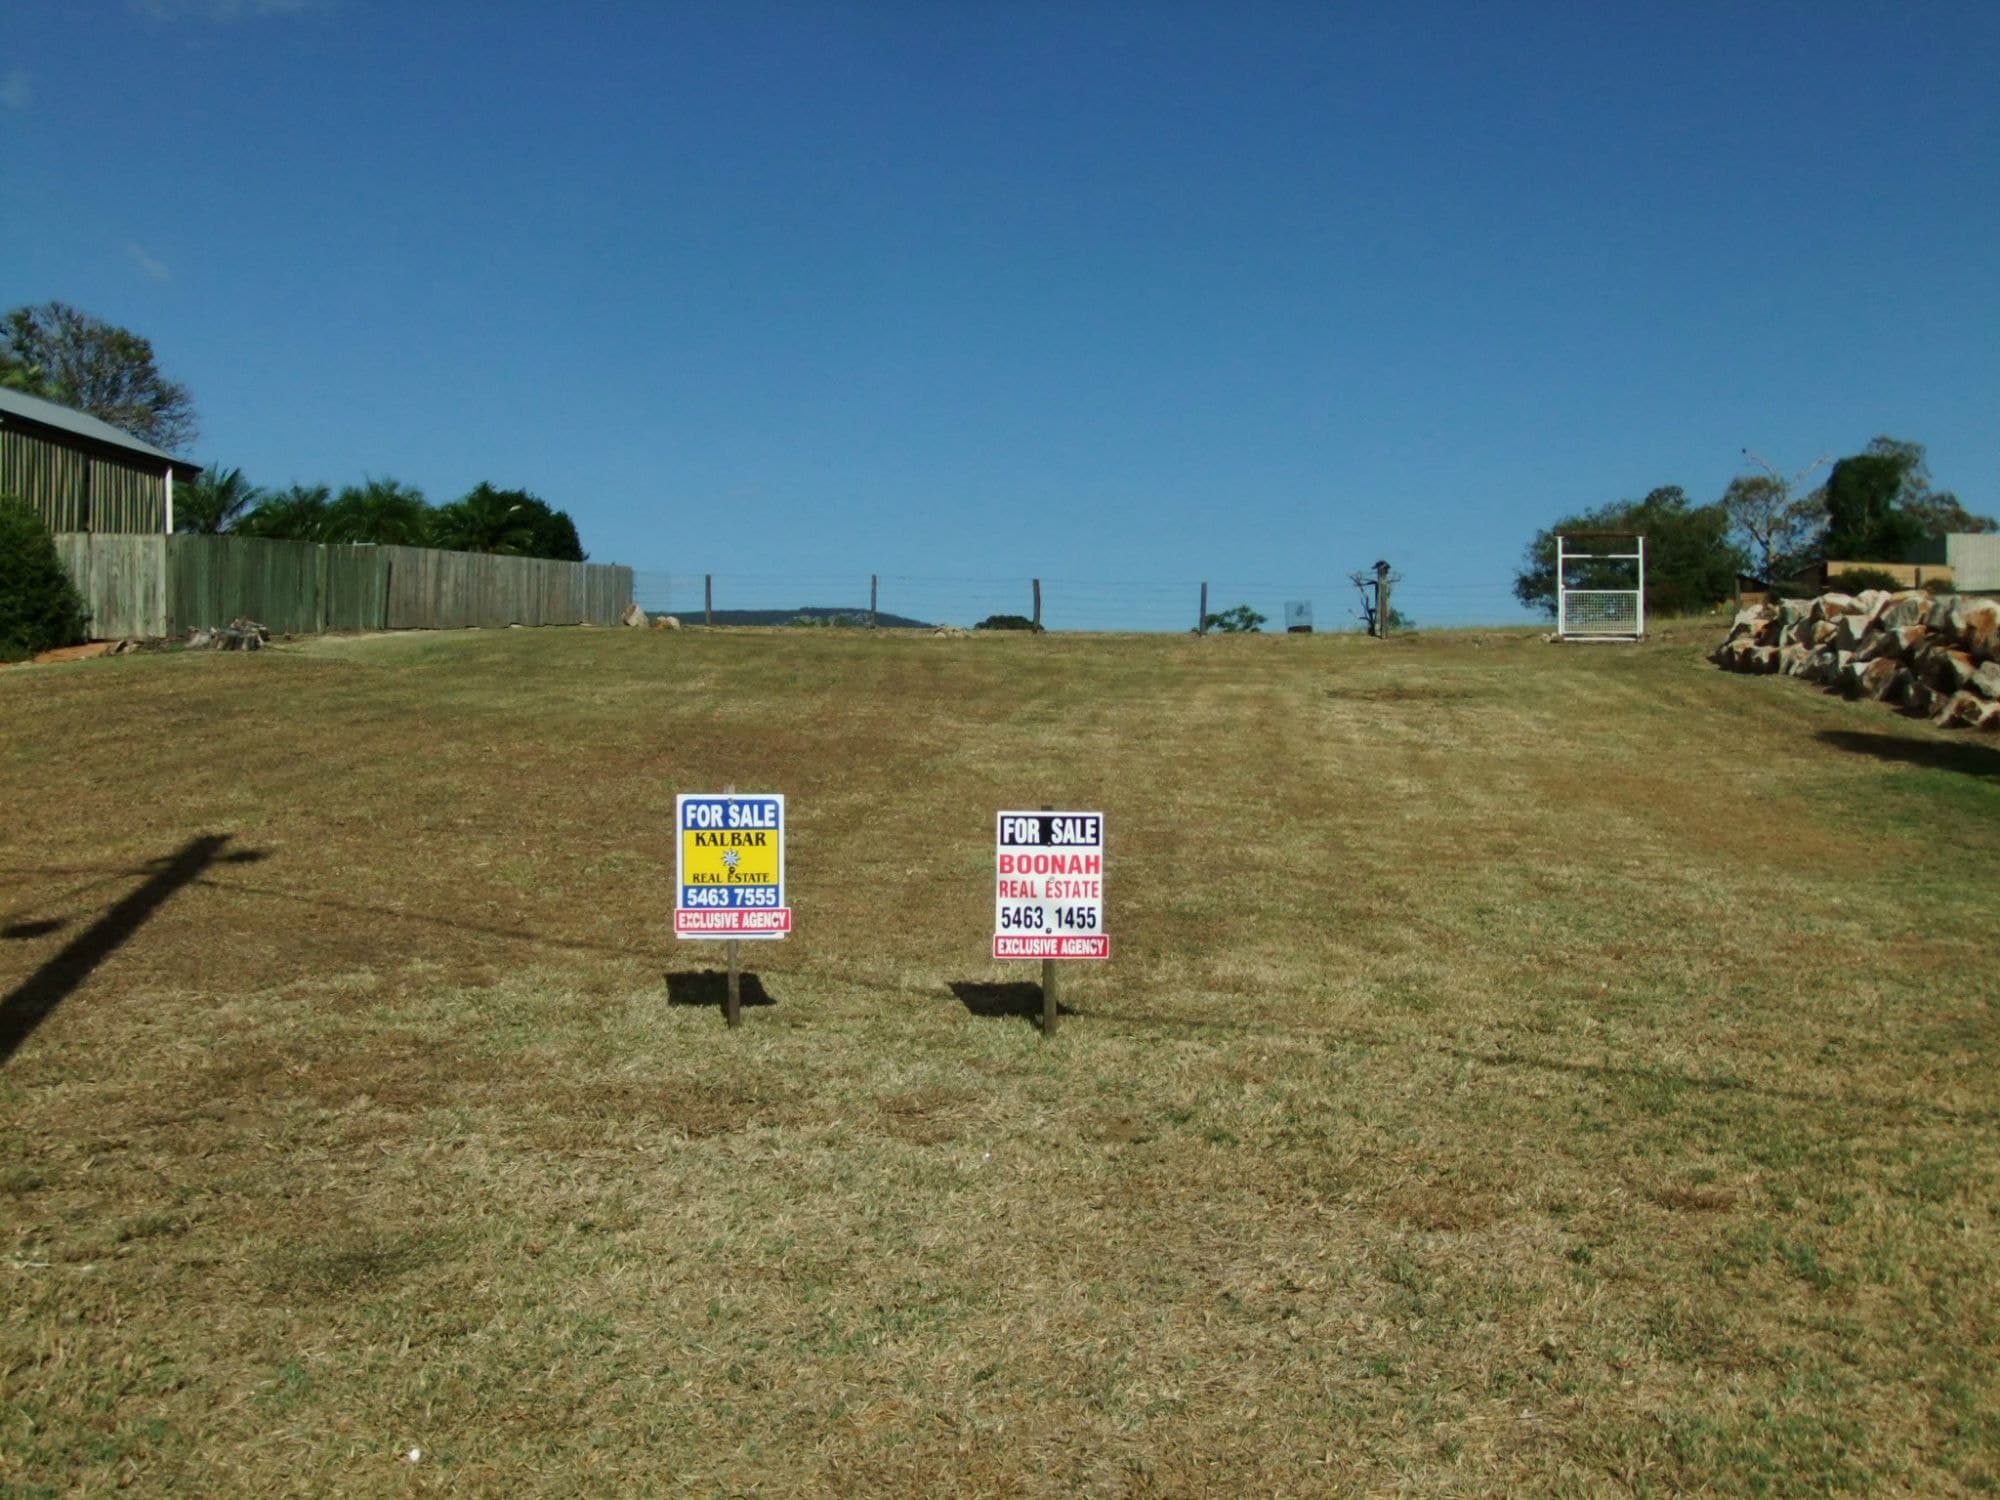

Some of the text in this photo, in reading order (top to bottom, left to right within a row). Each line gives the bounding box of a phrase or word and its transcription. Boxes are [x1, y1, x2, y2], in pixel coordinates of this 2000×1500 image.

[686, 804, 776, 828] FOR SALE
[695, 832, 766, 847] KALBAR
[1003, 818, 1096, 844] FOR SALE
[999, 854, 1100, 875] BOONAH
[692, 873, 770, 883] REAL ESTATE
[687, 888, 776, 906] 5463 7555
[999, 880, 1099, 898] REAL ESTATE
[678, 912, 786, 928] EXCLUSIVE AGENCY
[1001, 906, 1097, 929] 5463 1455
[997, 939, 1104, 955] EXCLUSIVE AGENCY
